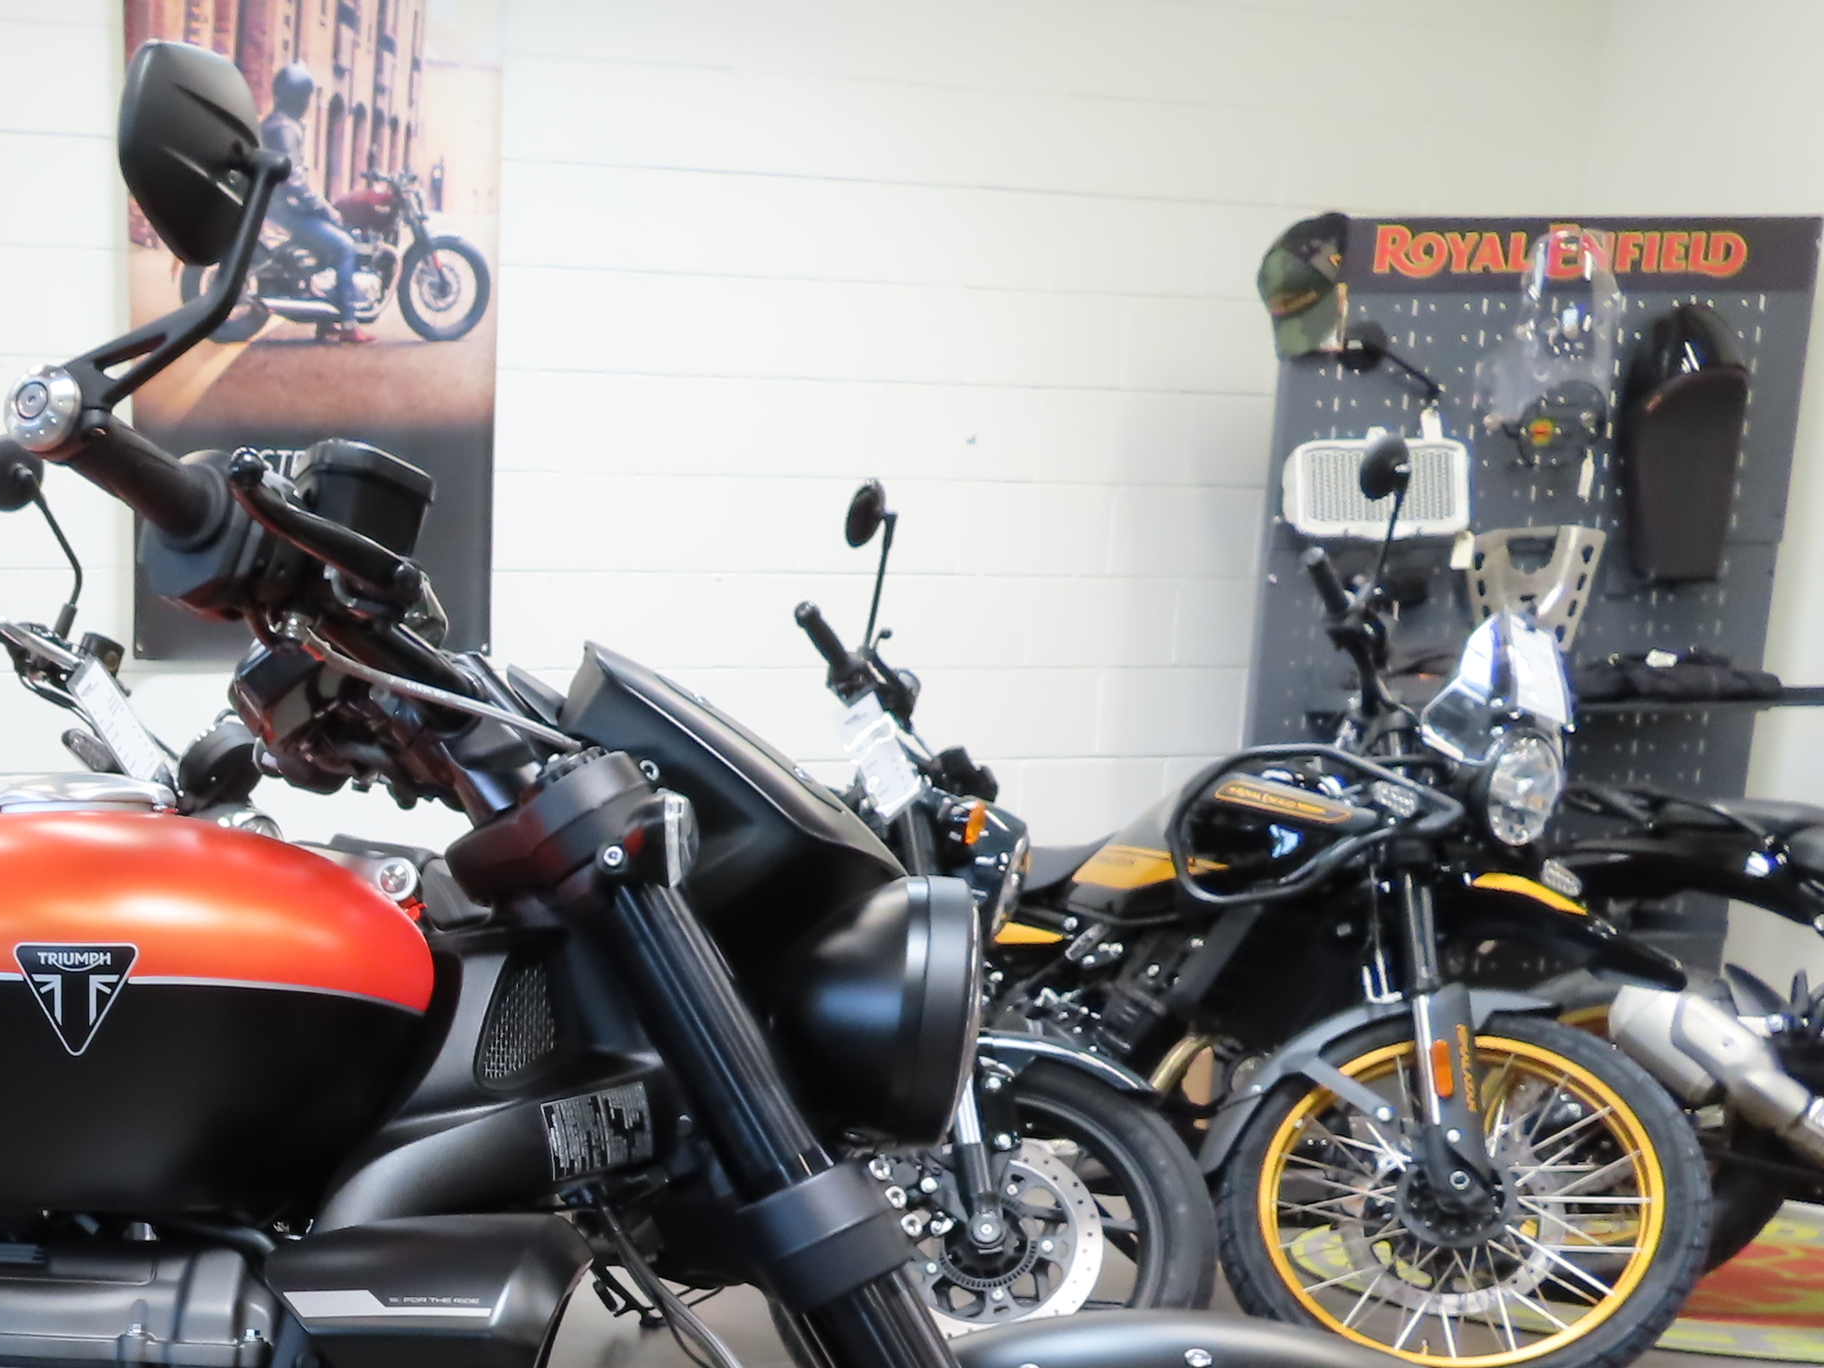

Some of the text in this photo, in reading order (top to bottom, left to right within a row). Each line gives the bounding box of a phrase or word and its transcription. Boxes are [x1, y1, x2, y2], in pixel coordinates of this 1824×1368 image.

[1373, 223, 1749, 279] ROYAL ENFIELD
[37, 952, 111, 972] TRIUMPH
[403, 1296, 480, 1305] FOR THE RIDE
